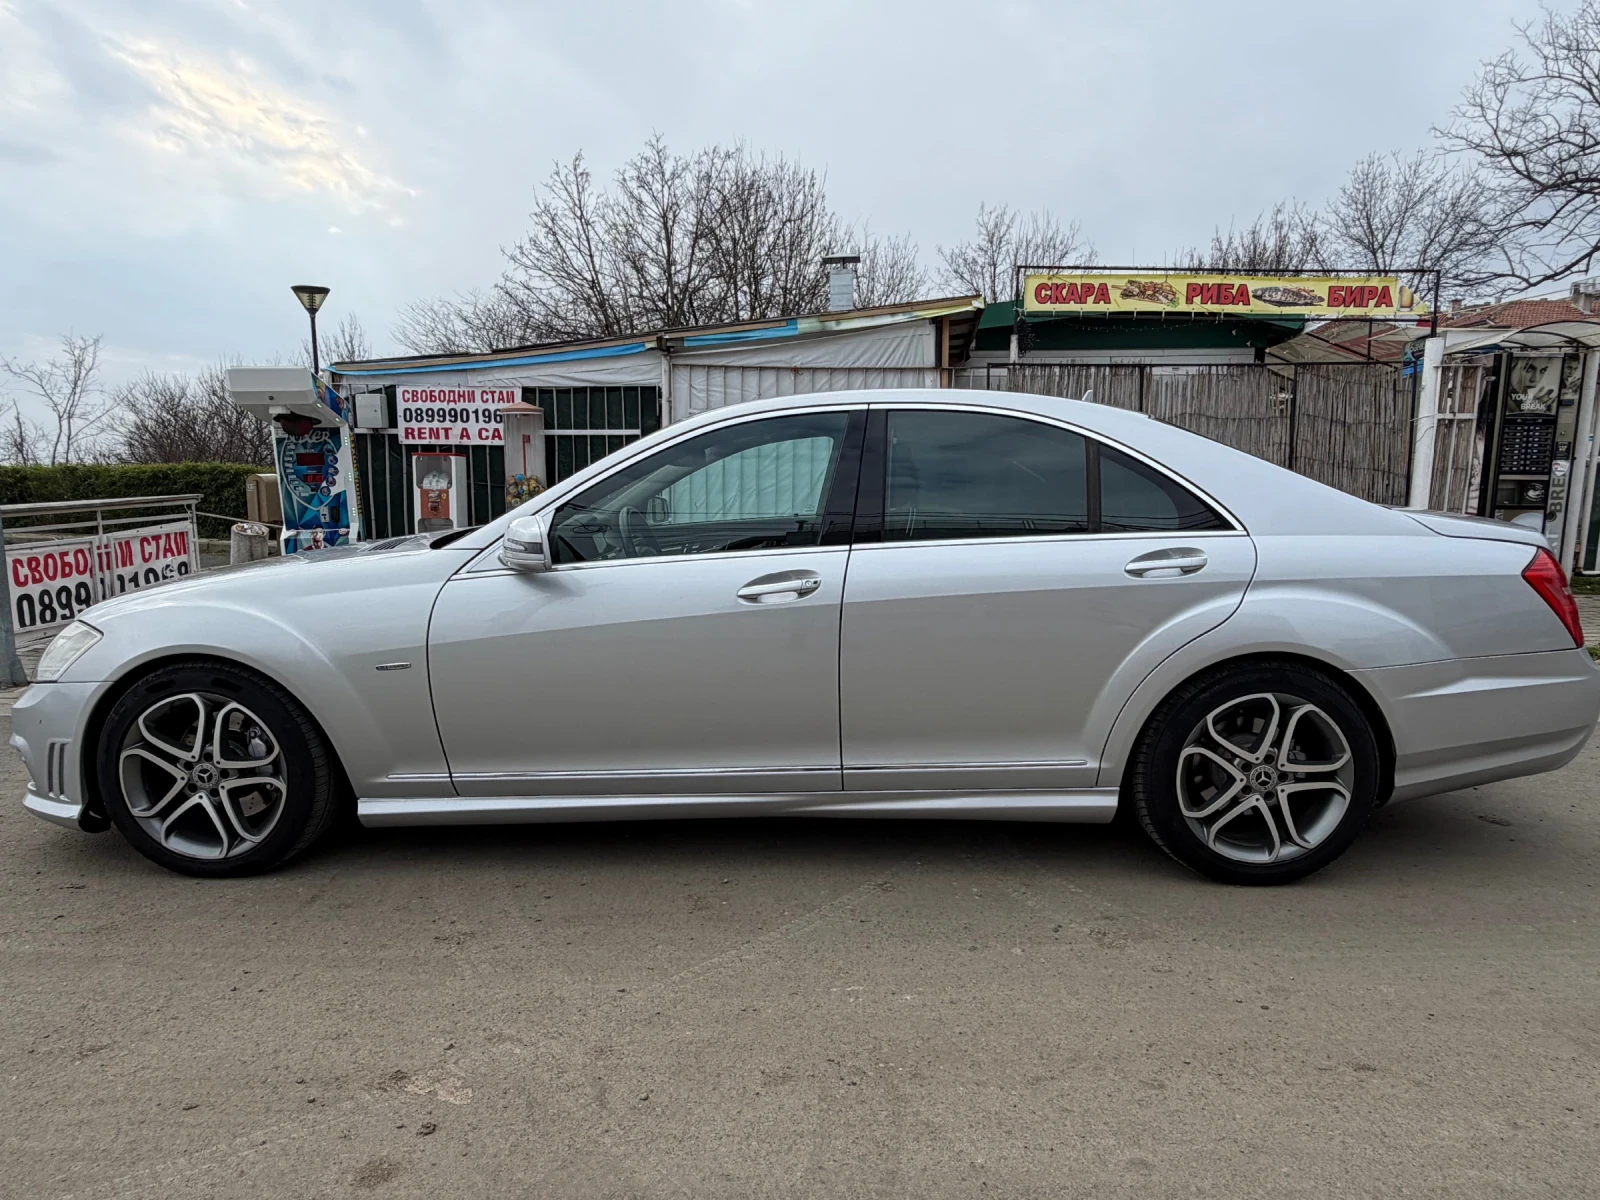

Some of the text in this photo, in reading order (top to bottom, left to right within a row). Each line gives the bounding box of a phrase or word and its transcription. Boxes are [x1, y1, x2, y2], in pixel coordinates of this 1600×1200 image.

[1034, 282, 1394, 308] СКАРА РИБА БИРА
[401, 389, 515, 405] СВОБОДНИ СТАИ
[403, 407, 503, 424] 089990196
[404, 427, 503, 441] RENT A CA
[1549, 475, 1566, 513] BRE
[139, 531, 188, 564] СТАИ
